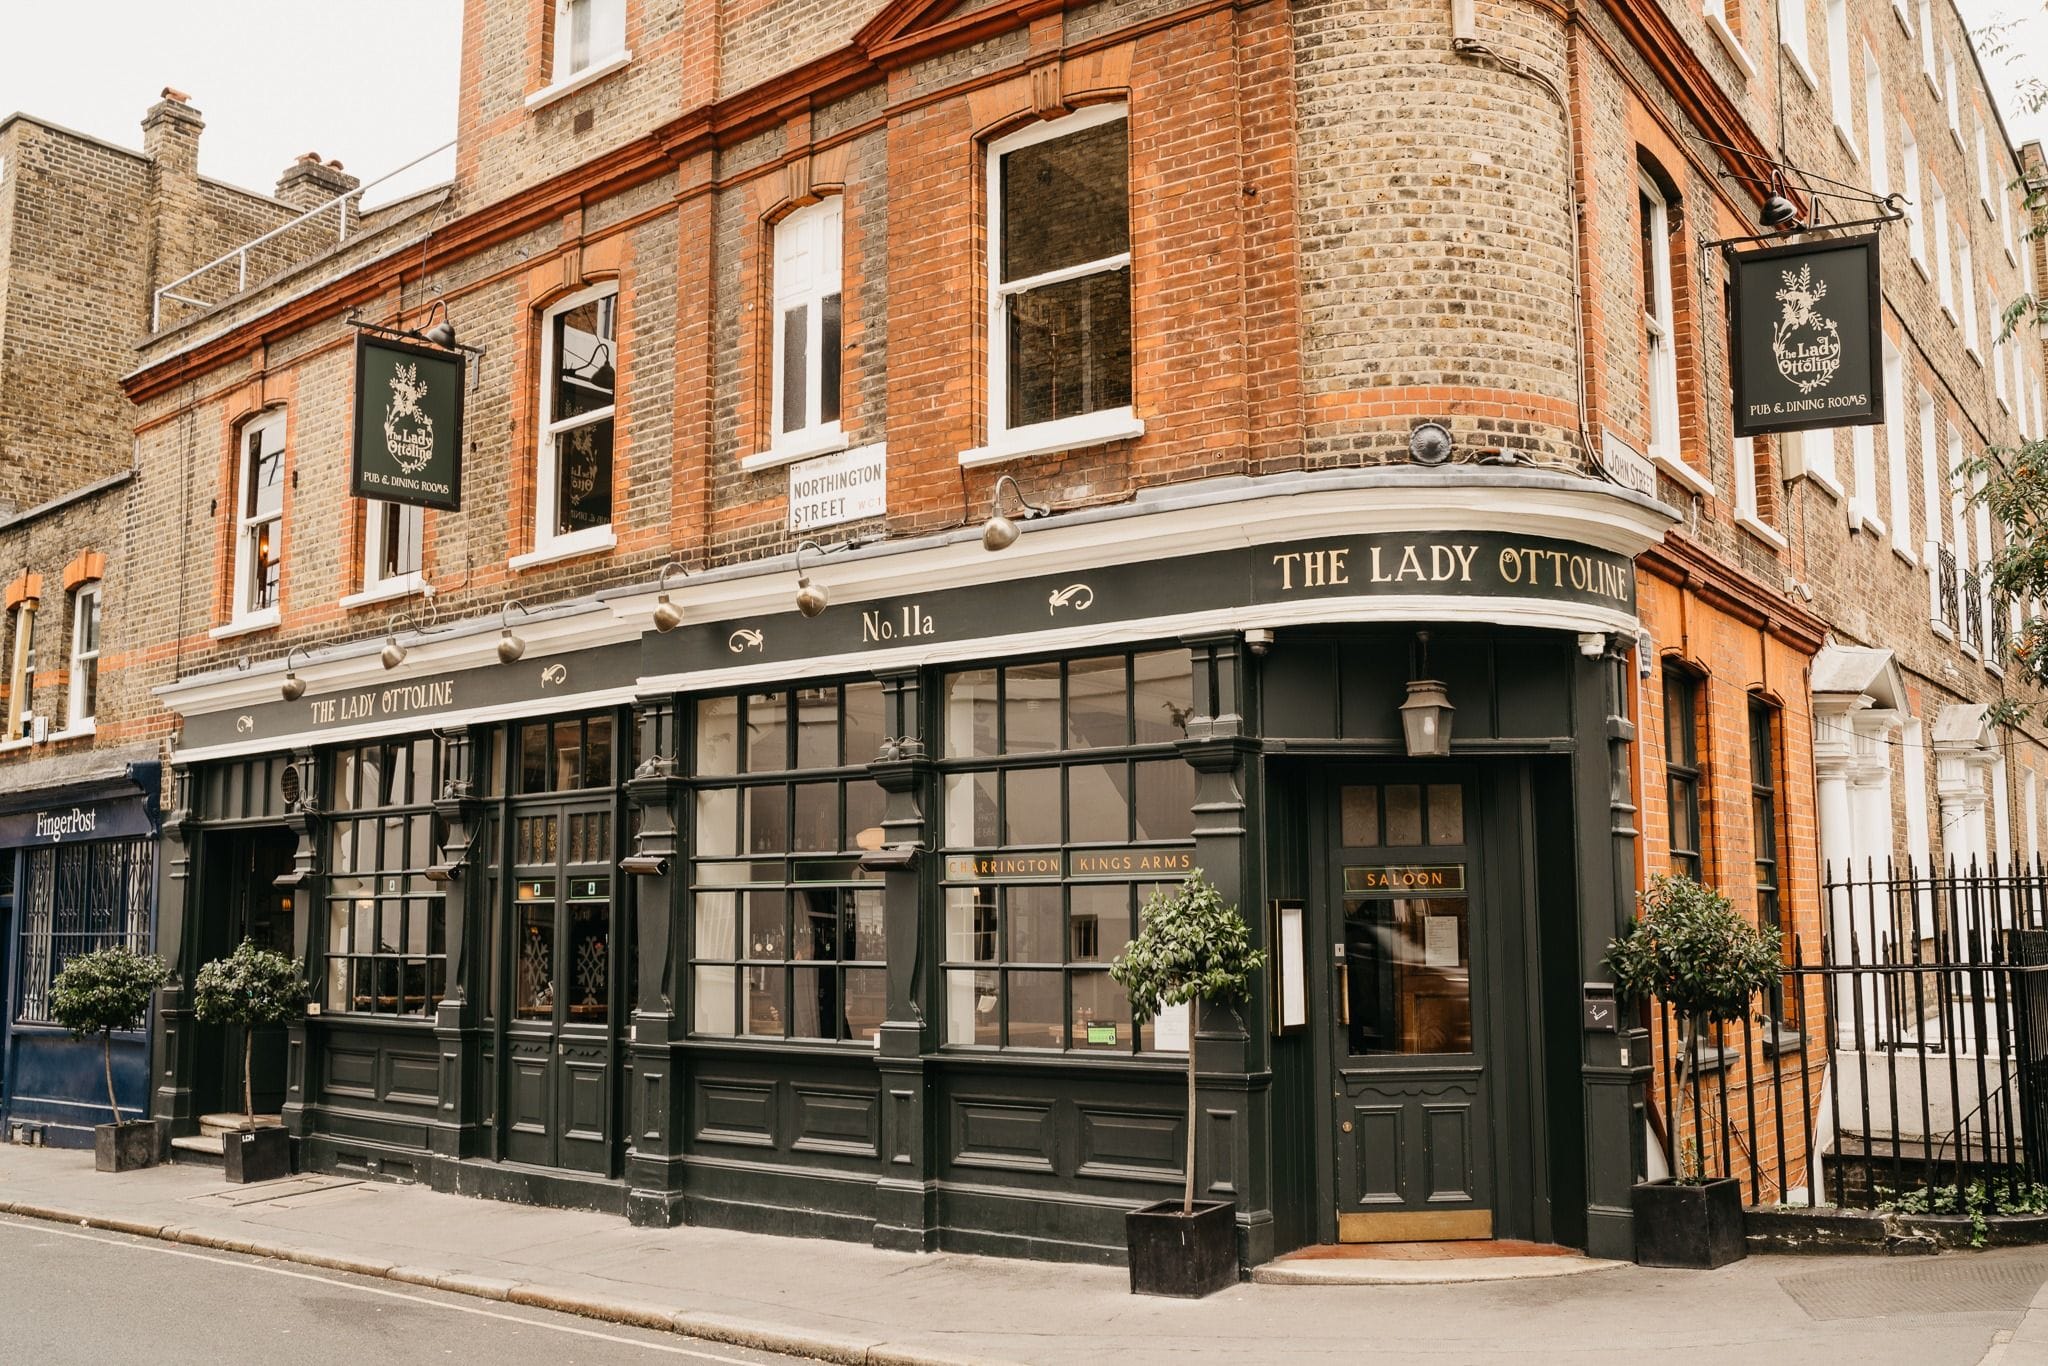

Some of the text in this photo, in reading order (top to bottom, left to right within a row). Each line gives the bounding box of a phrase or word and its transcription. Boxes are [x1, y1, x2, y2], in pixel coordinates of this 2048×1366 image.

[1797, 336, 1840, 361] Lady
[1779, 356, 1840, 375] Ottoline
[1750, 394, 1867, 416] PUB & DINING ROOMS
[388, 440, 433, 460] Ottoline
[402, 428, 433, 450] Lady
[363, 471, 449, 494] PUB & DINING ROOMS
[794, 463, 881, 499] NORTHINGTON
[1609, 450, 1653, 496] JOHN STREET
[794, 497, 846, 524] STREET
[1273, 545, 1629, 602] THE LADY OTTOLINE
[862, 610, 898, 643] No.
[310, 679, 454, 724] THE LADY OTTOLINE
[35, 807, 96, 842] FingerPost
[949, 853, 1190, 875] CHARRINGTON KINGS ARMS
[1367, 872, 1442, 886] SALOON
